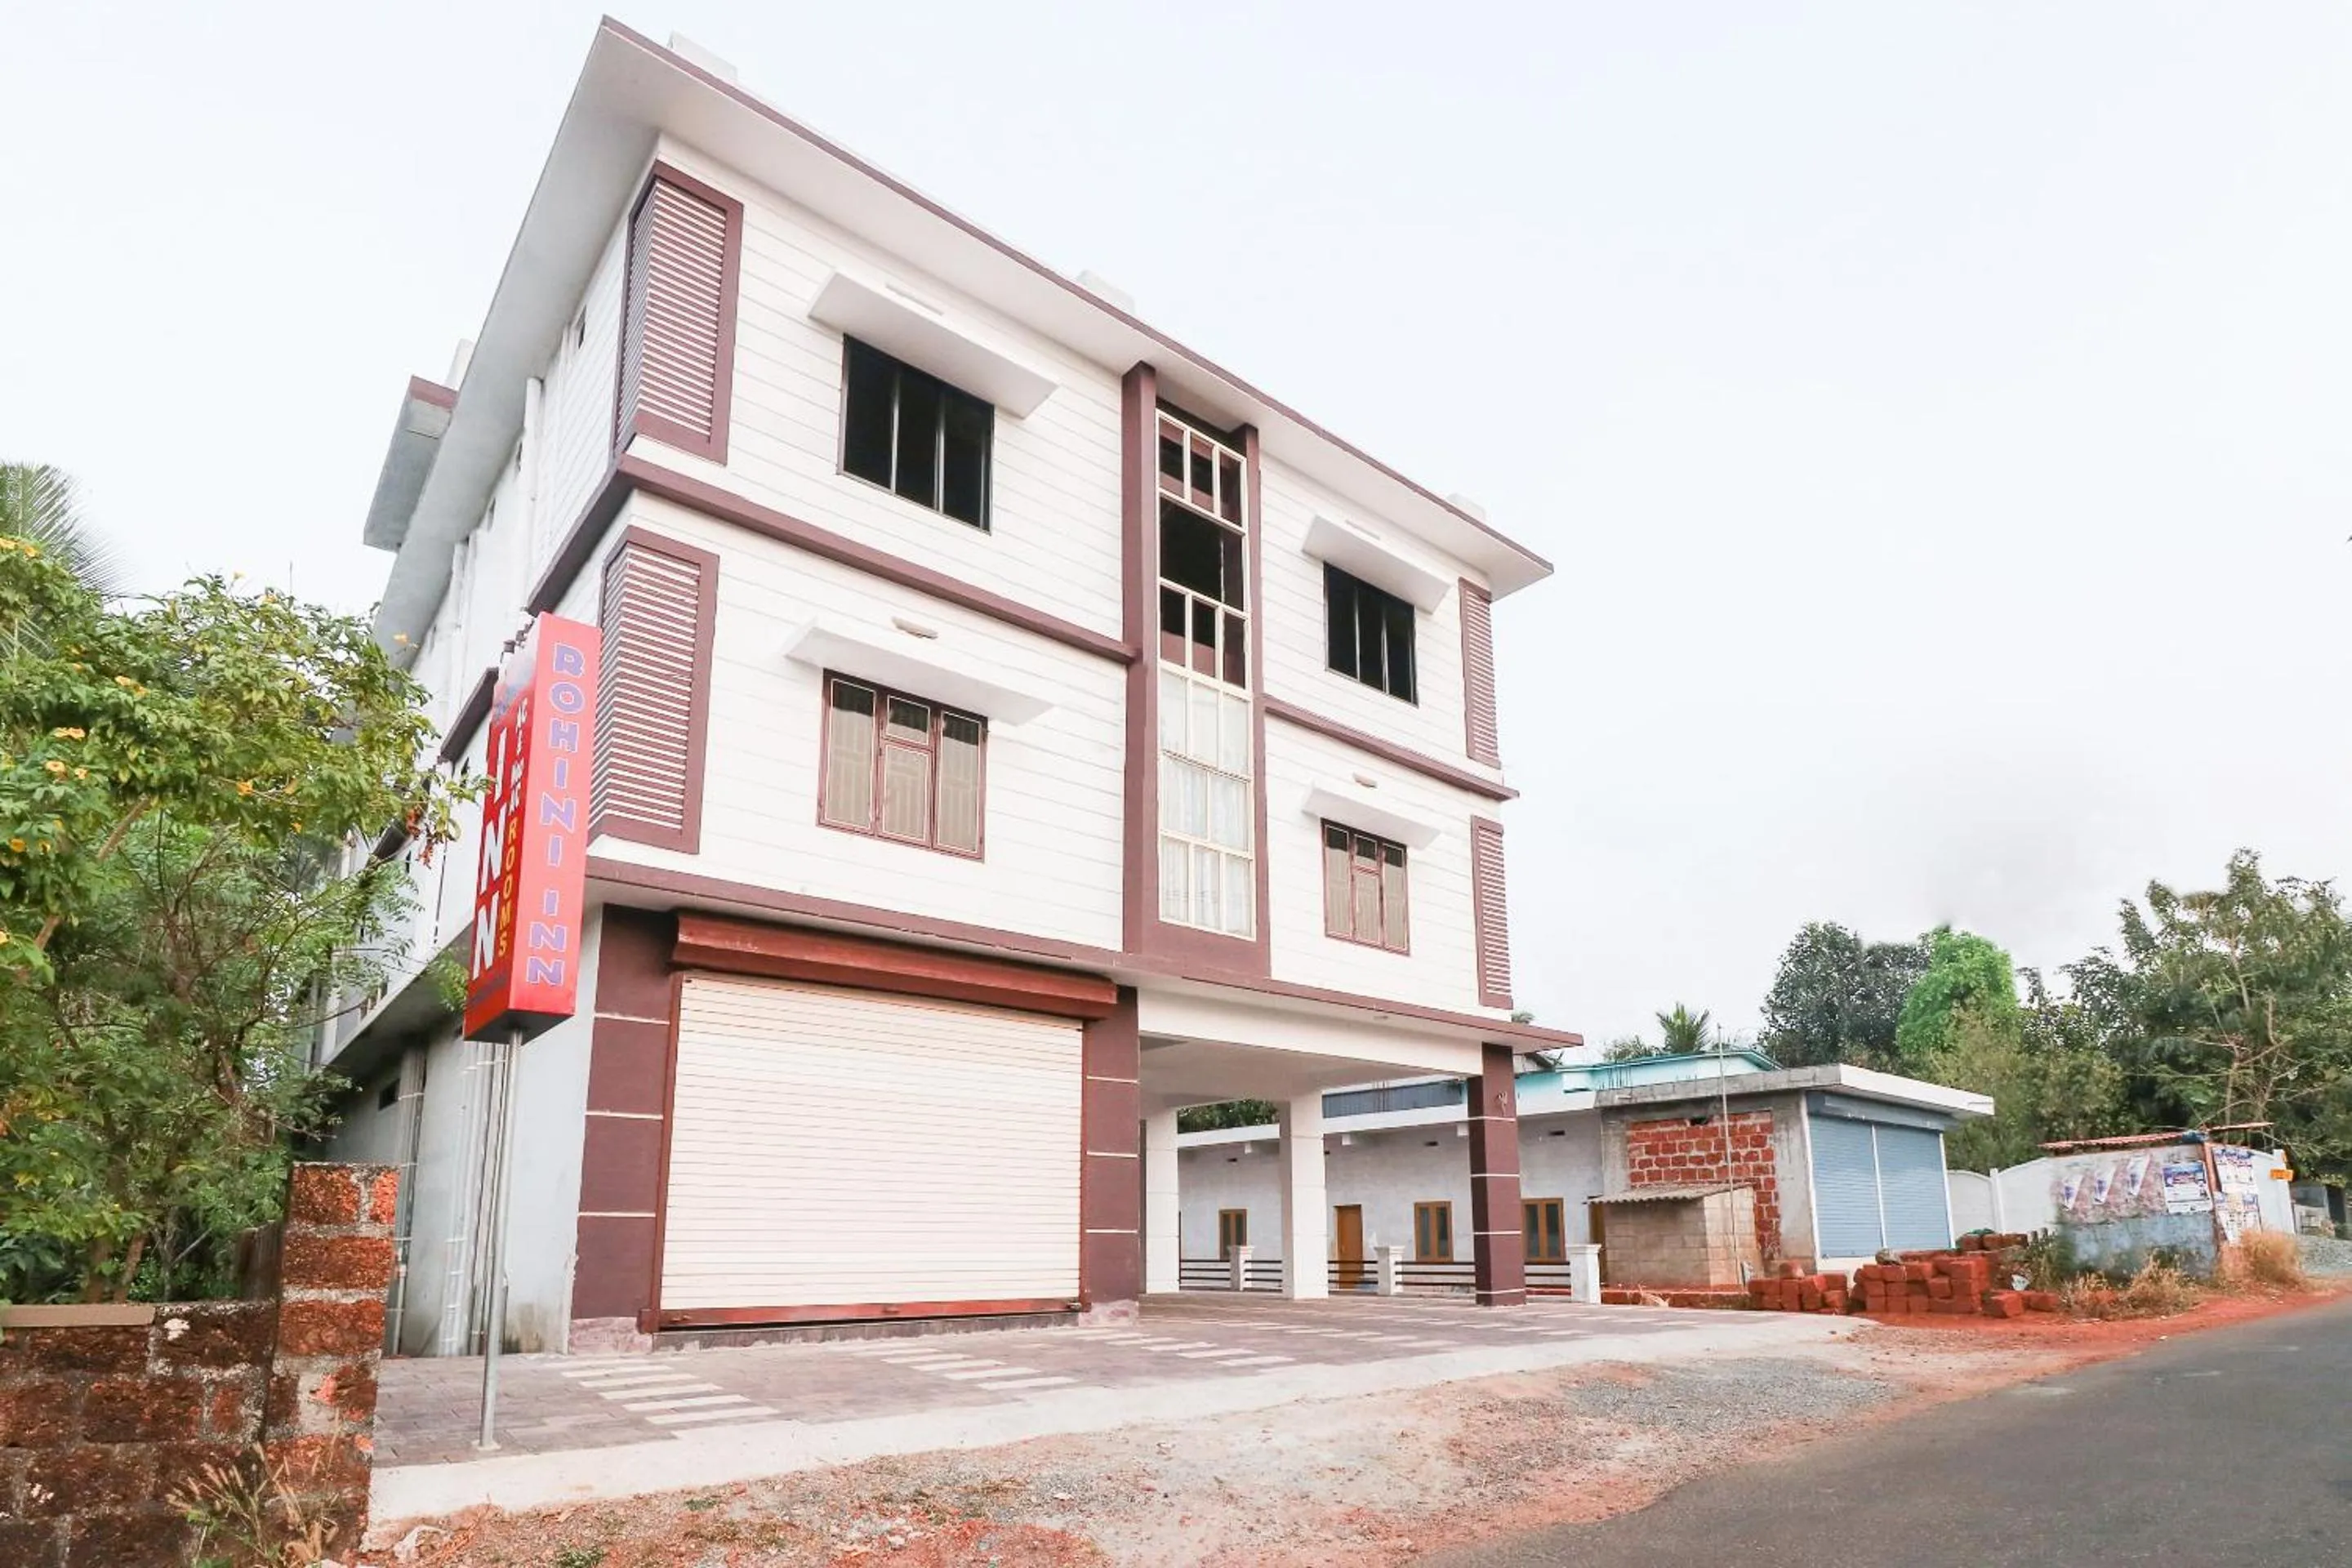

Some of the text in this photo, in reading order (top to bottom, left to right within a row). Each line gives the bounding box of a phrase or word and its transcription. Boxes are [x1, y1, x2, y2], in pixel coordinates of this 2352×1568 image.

[472, 726, 508, 981] INN
[498, 817, 518, 957] ROOMS
[527, 642, 586, 987] ROHINI INN
